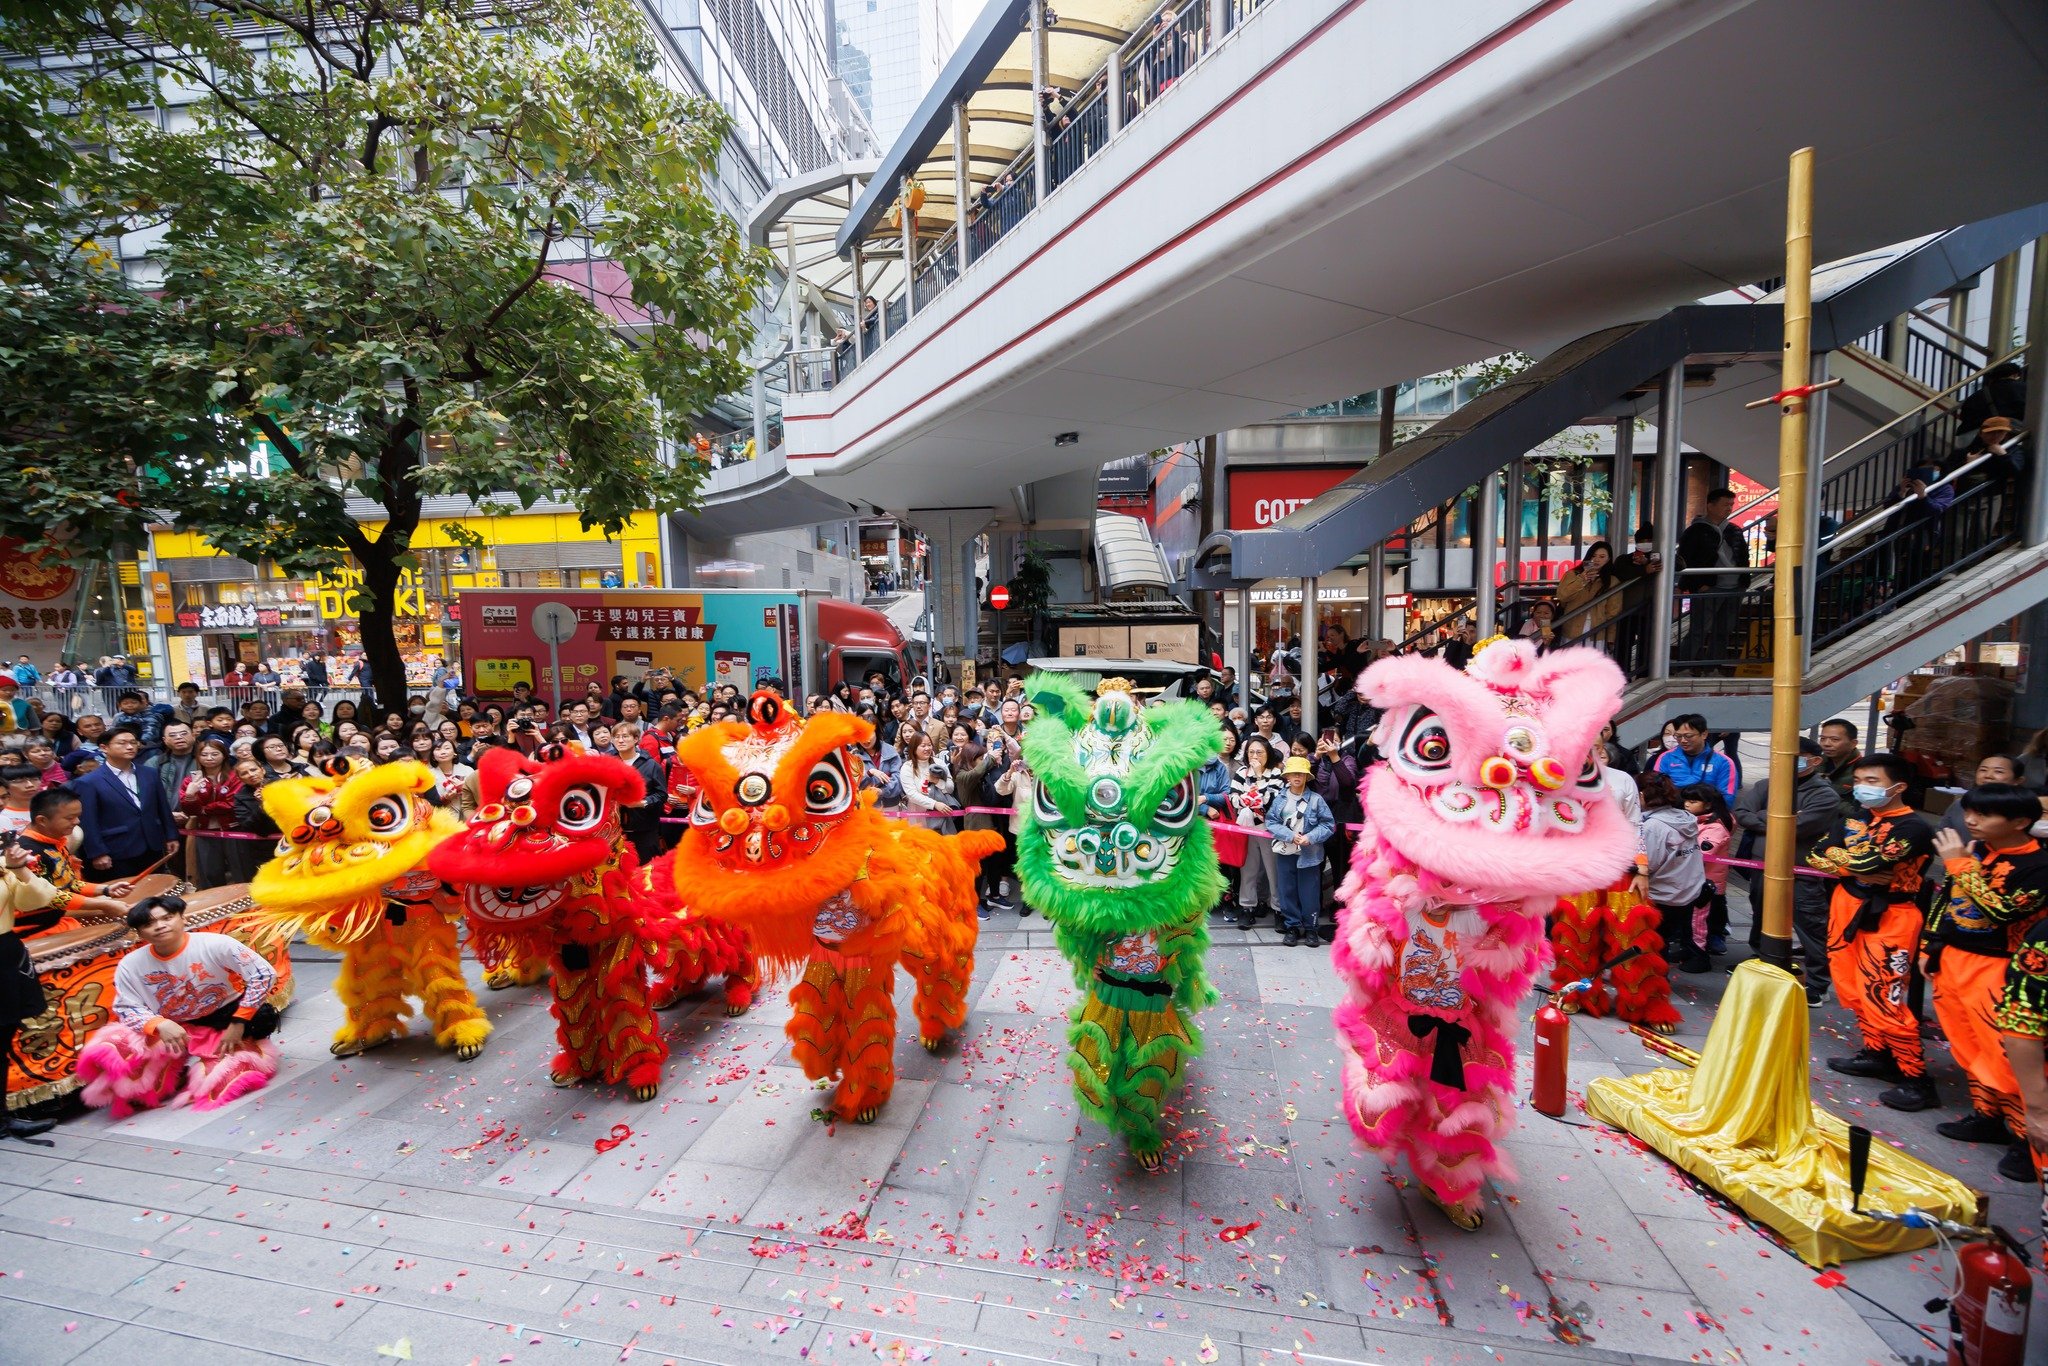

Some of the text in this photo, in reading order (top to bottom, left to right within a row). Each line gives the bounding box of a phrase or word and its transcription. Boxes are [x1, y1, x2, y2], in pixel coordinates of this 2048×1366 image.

[1738, 494, 1780, 502] CHIS
[1494, 560, 1583, 588] CTTO
[1250, 588, 1348, 600] WINGS BDING
[319, 588, 426, 619] DKI
[610, 626, 704, 640] 守護孩子健康
